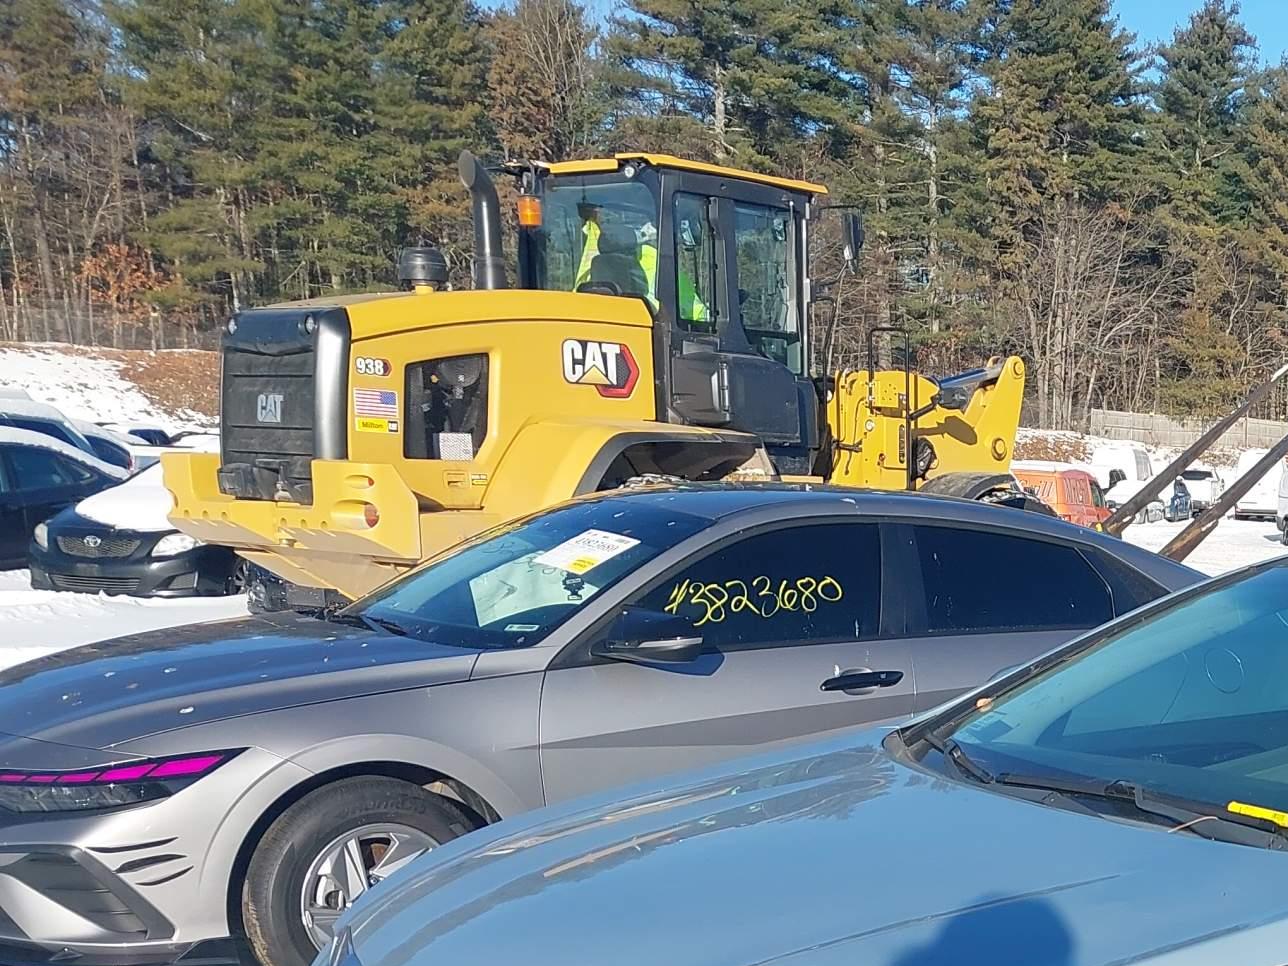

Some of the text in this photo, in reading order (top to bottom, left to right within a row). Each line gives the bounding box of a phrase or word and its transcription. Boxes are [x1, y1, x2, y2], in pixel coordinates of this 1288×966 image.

[355, 357, 384, 376] 938
[562, 339, 621, 385] CAT
[257, 393, 284, 422] CAT
